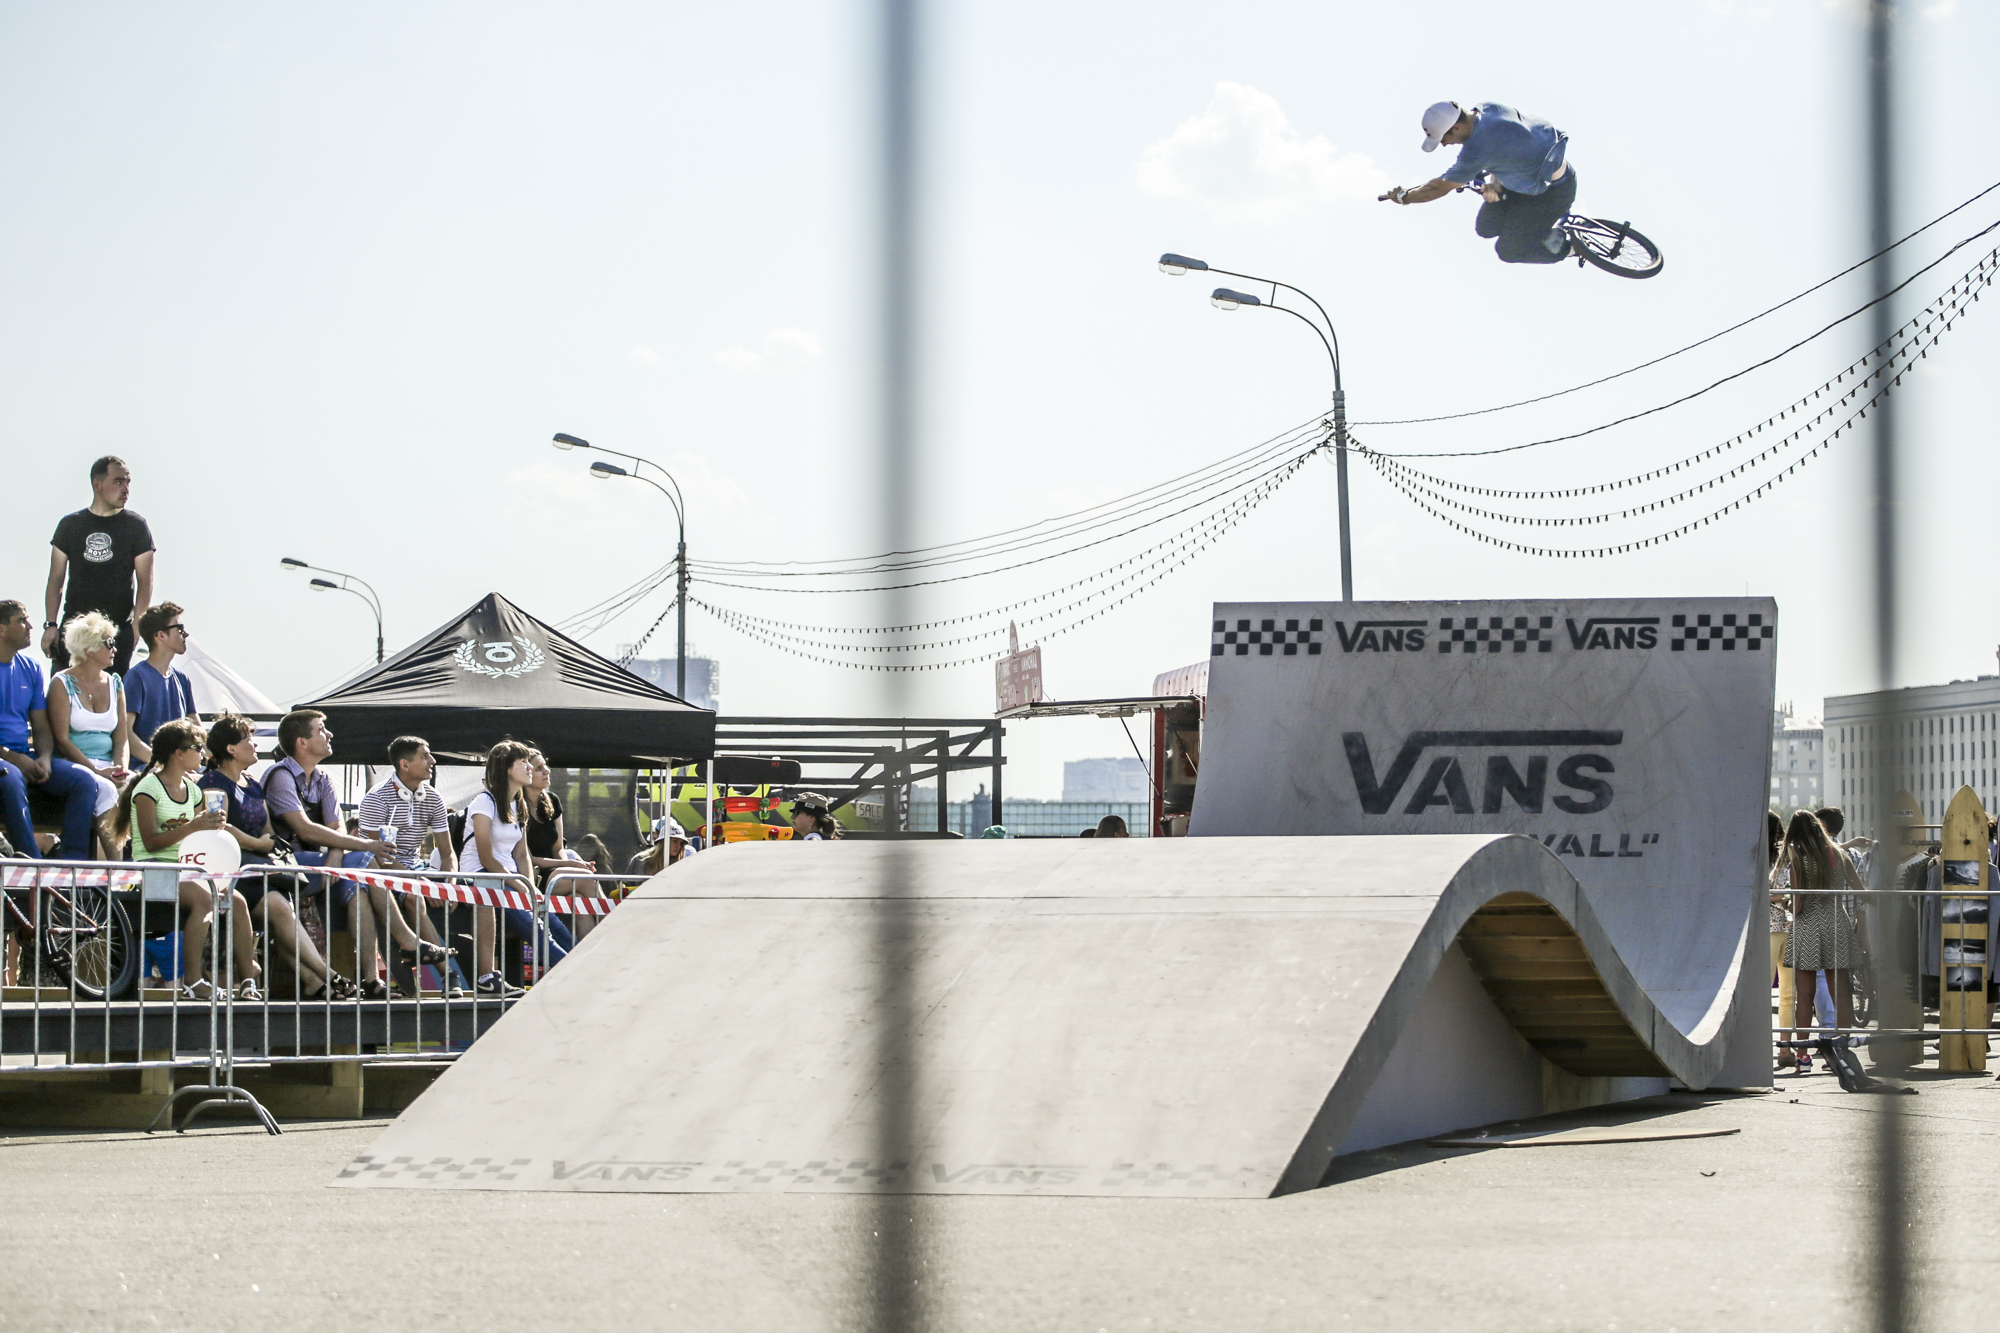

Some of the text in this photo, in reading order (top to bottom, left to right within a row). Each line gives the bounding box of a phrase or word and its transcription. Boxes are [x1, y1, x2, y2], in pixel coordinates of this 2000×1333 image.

[1335, 617, 1660, 652] VANS VANS
[1342, 730, 1624, 814] VANS
[859, 803, 882, 818] SALE
[553, 1160, 703, 1180] VANS
[932, 1163, 1088, 1184] VANS
